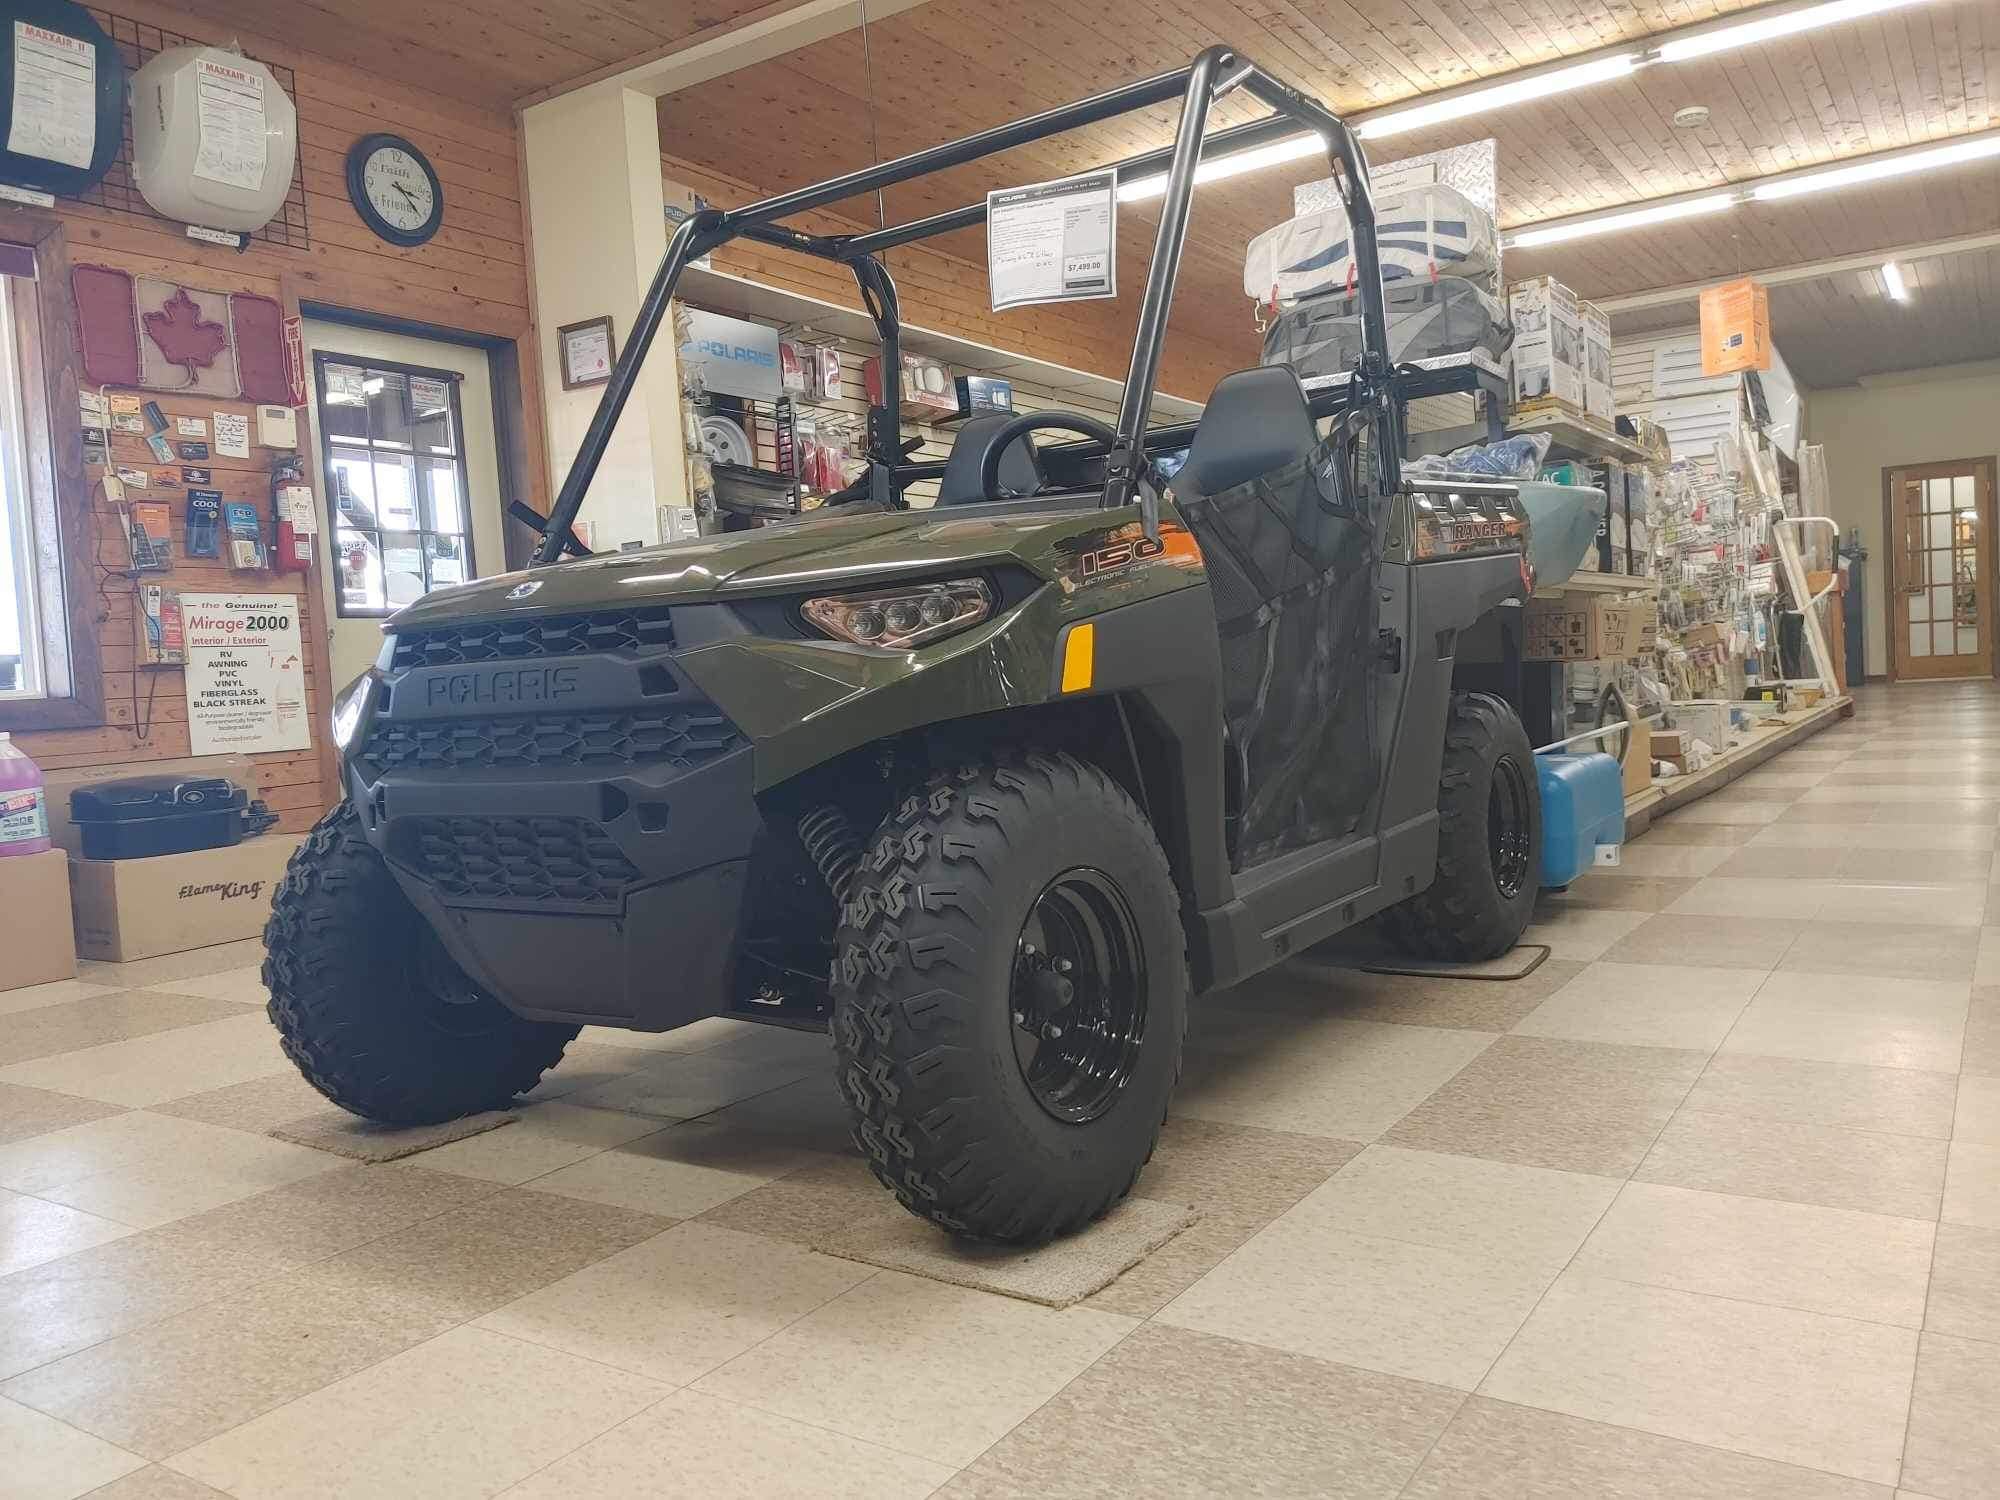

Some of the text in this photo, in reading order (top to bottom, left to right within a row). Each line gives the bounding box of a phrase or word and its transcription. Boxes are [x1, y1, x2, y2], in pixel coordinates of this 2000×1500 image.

[25, 26, 74, 49] MAXXAIR
[205, 63, 246, 81] MAXXAIR
[192, 500, 219, 509] COOL
[1455, 521, 1506, 540] RANGER
[189, 616, 289, 633] Mirage 2000
[191, 637, 225, 645] Interior
[232, 636, 266, 645] Exterior
[208, 660, 248, 668] AWNING
[214, 680, 244, 688] VINYL
[426, 667, 580, 707] POLARIS
[201, 689, 259, 698] FIBERGLASS
[193, 698, 266, 708] BLACK STREAK
